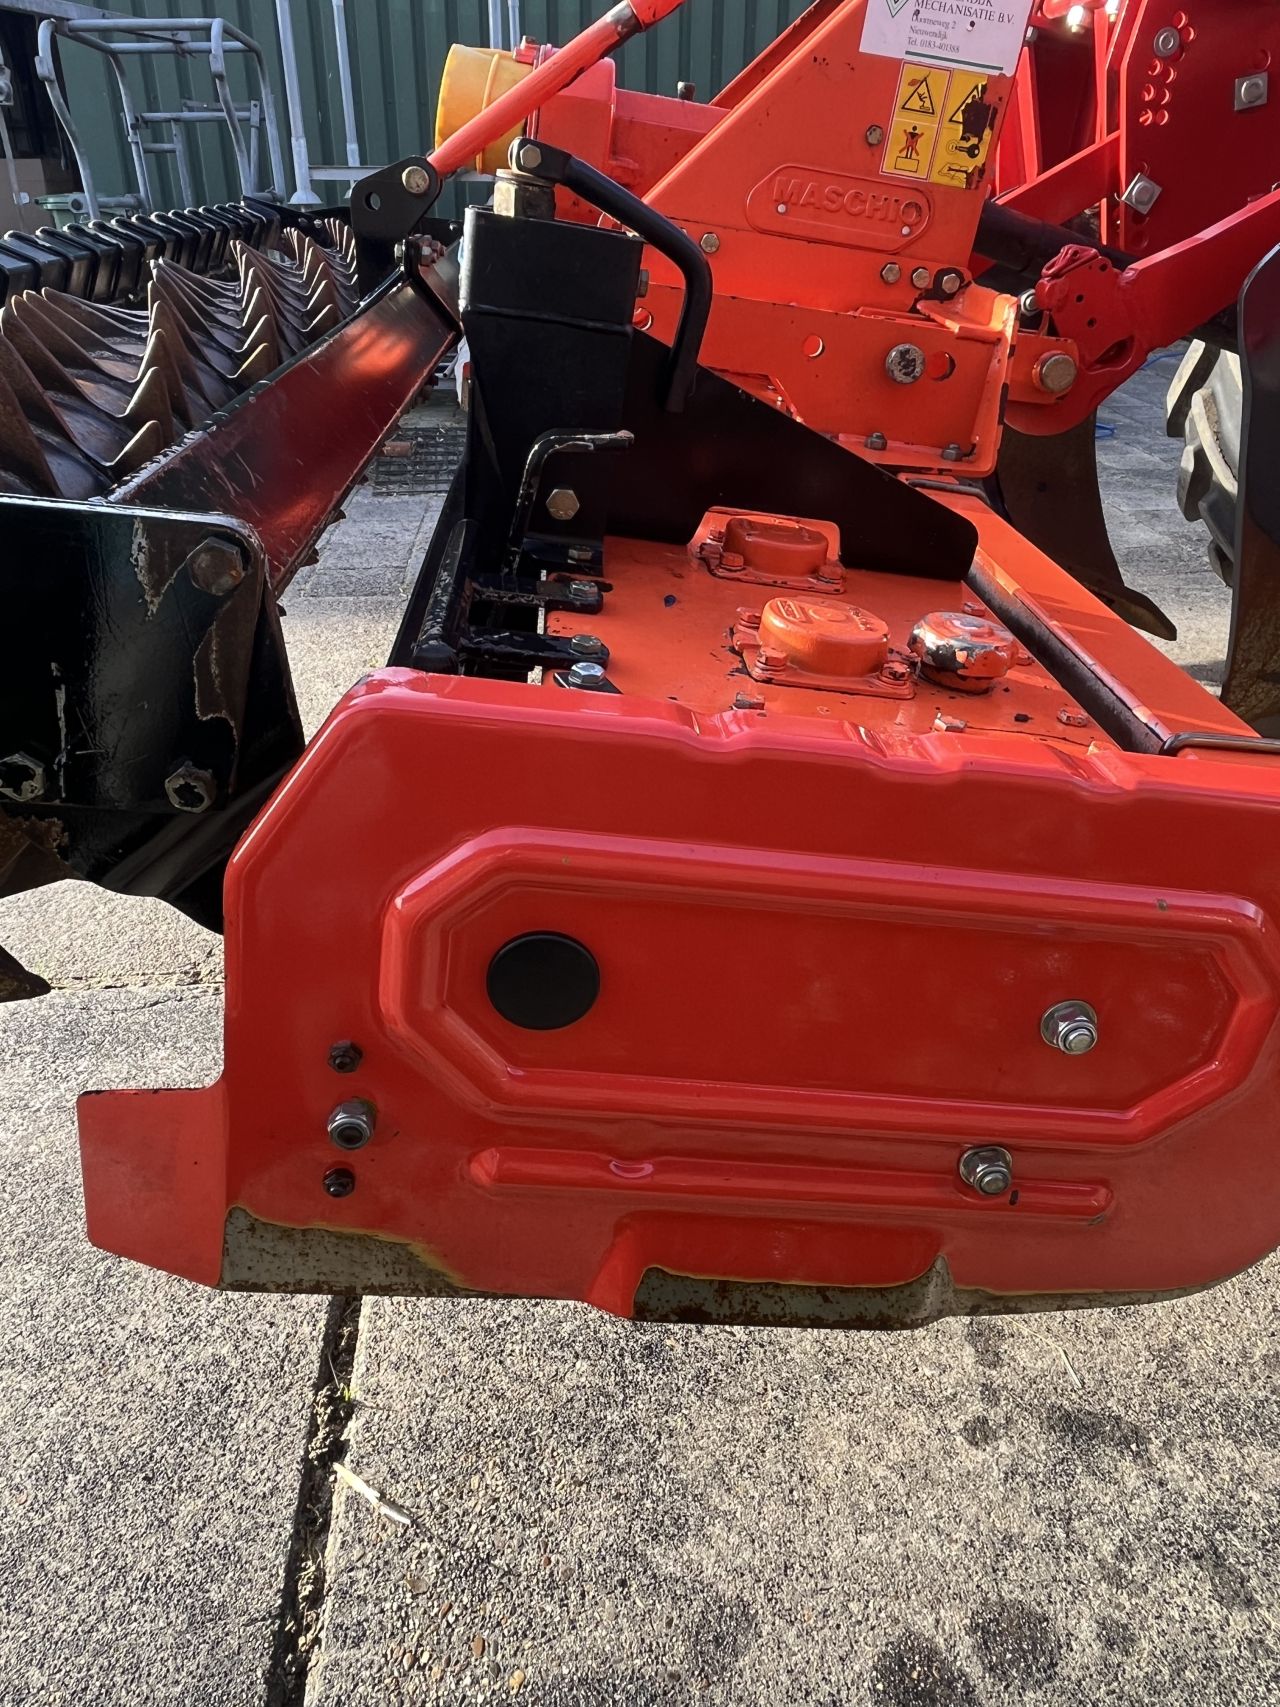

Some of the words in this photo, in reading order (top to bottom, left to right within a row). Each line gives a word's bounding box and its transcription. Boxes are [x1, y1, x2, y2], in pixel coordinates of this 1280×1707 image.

[914, 0, 995, 21] MECHANISATIE
[998, 13, 1014, 25] B.V.
[951, 20, 957, 29] 2
[910, 25, 947, 40] Nieuwendijk
[908, 37, 918, 46] Tel.
[773, 176, 923, 225] MASCHIO
